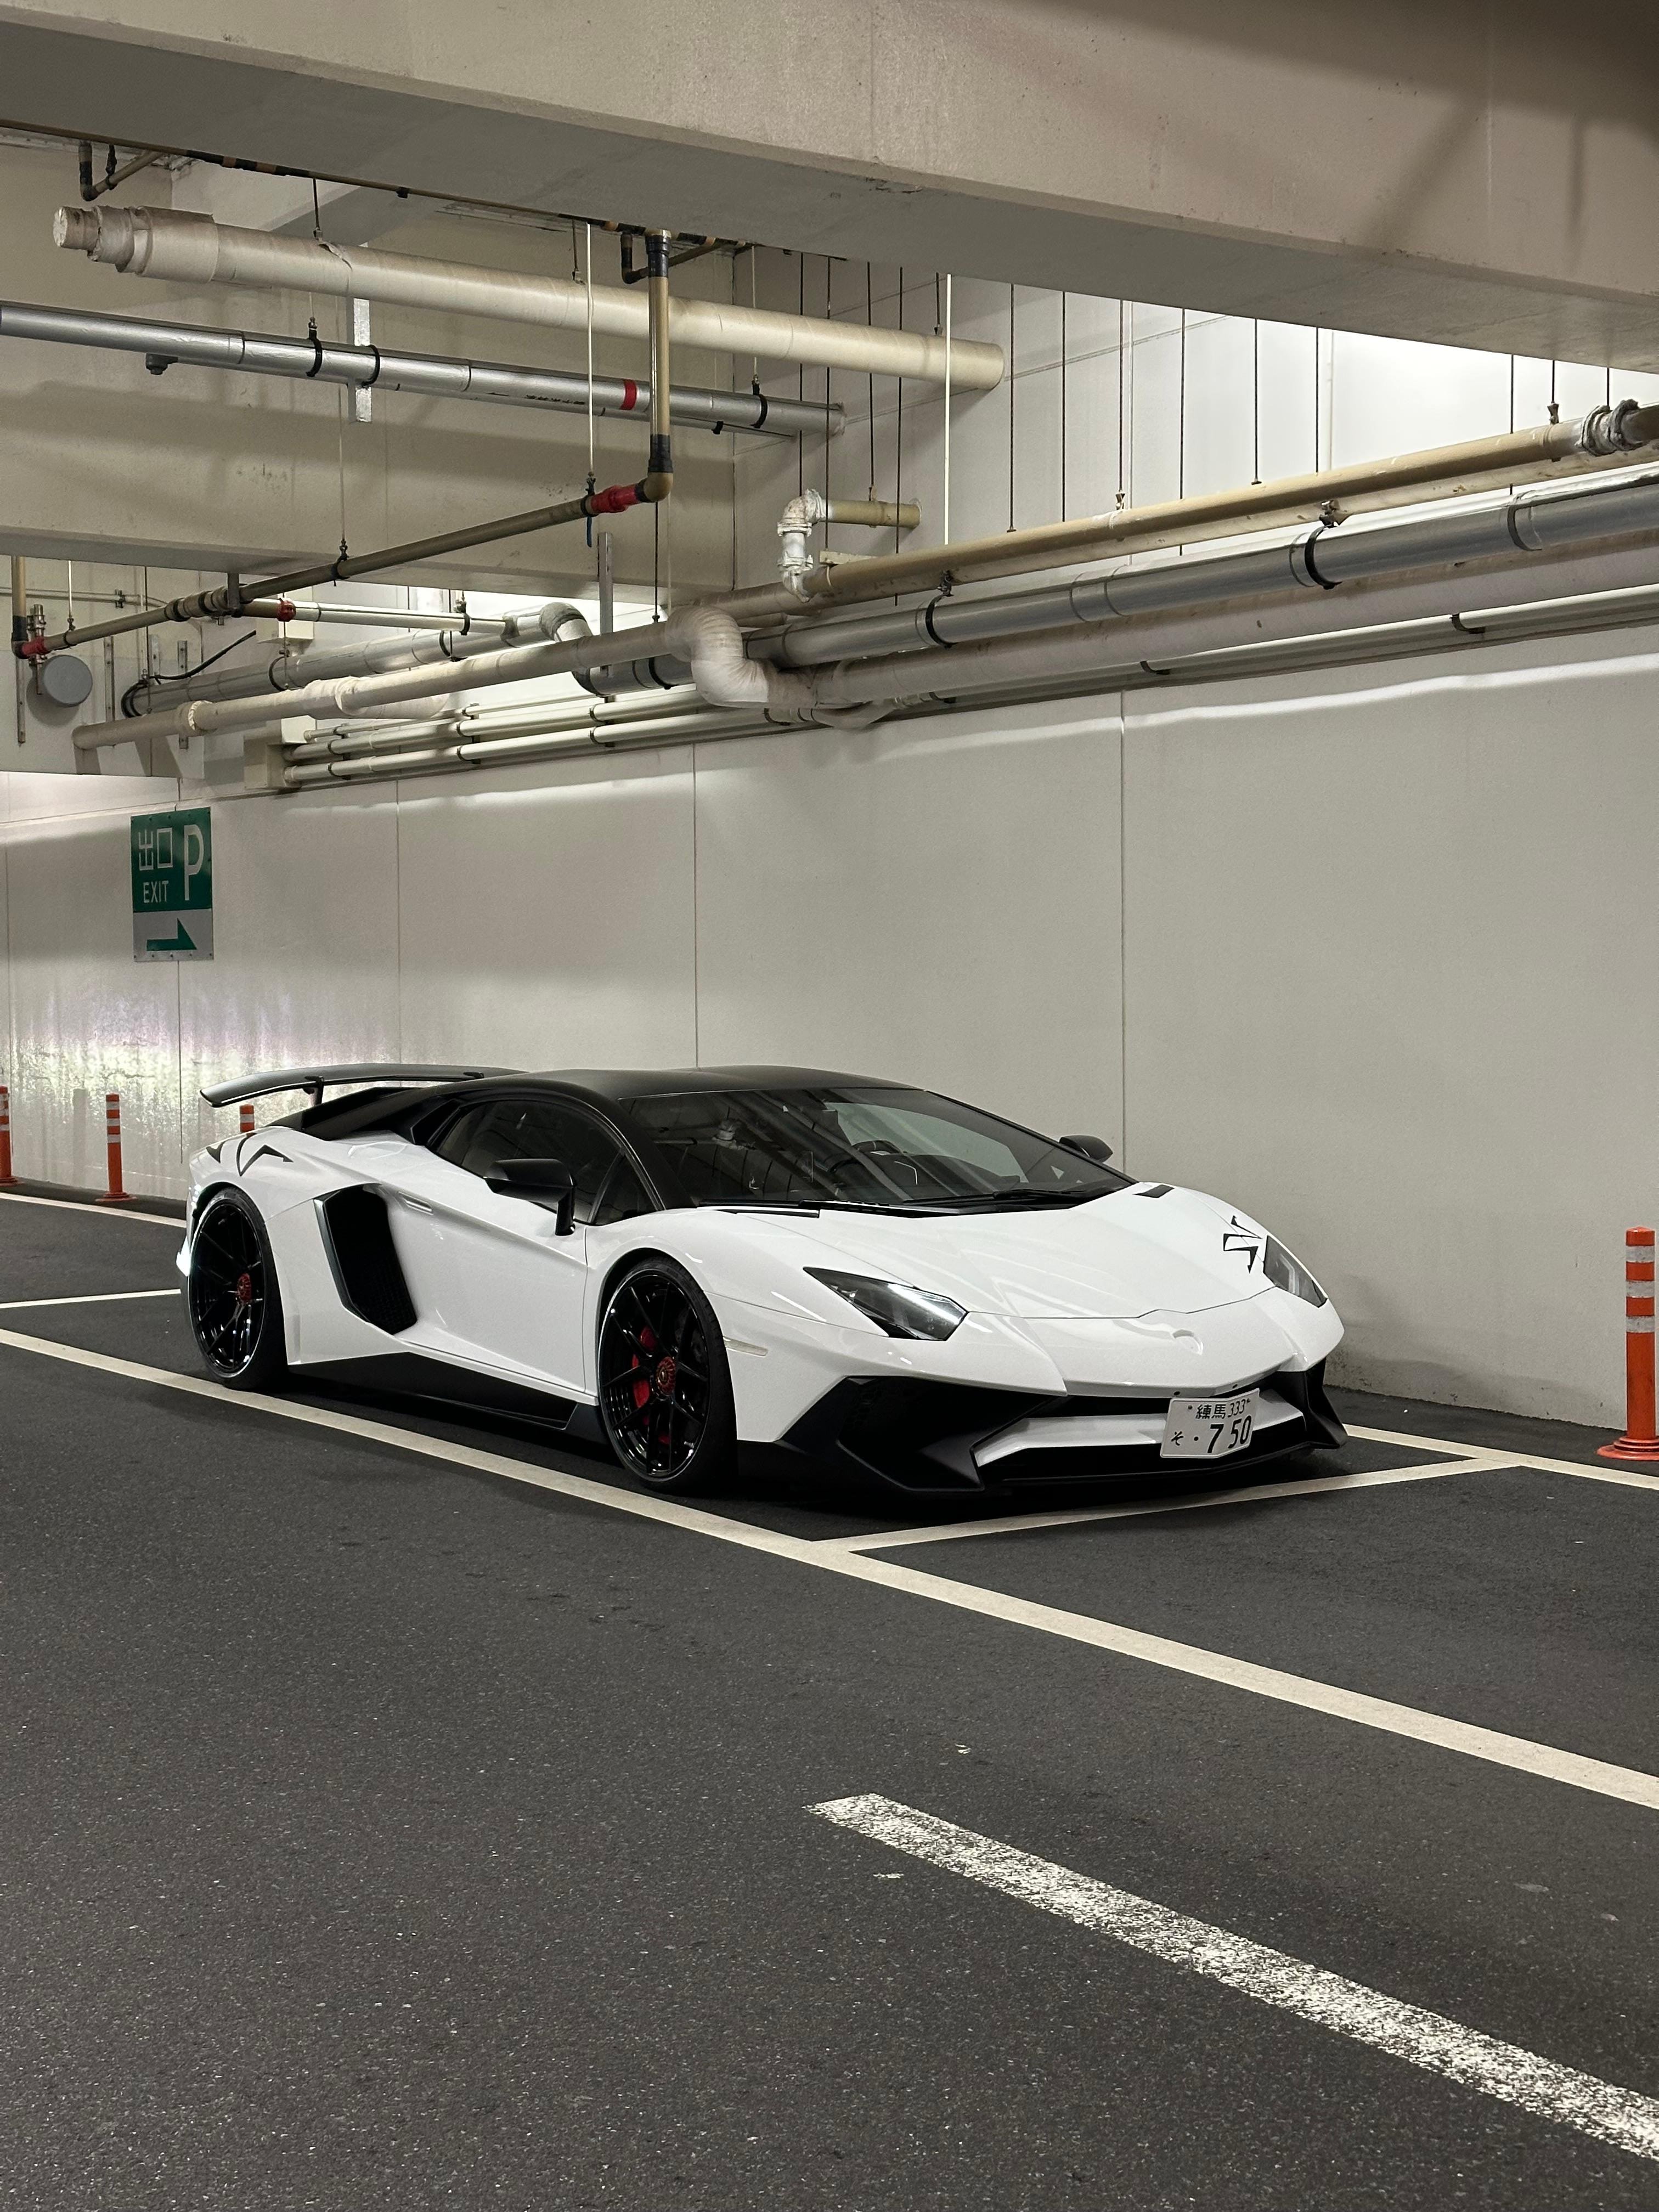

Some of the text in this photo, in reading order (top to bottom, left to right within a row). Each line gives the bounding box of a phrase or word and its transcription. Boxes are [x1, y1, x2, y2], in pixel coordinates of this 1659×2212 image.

[138, 828, 173, 871] 出口
[184, 824, 204, 901] P
[143, 881, 169, 903] EXIT
[1195, 1399, 1246, 1419] 練馬 333
[1171, 1431, 1184, 1446] そ
